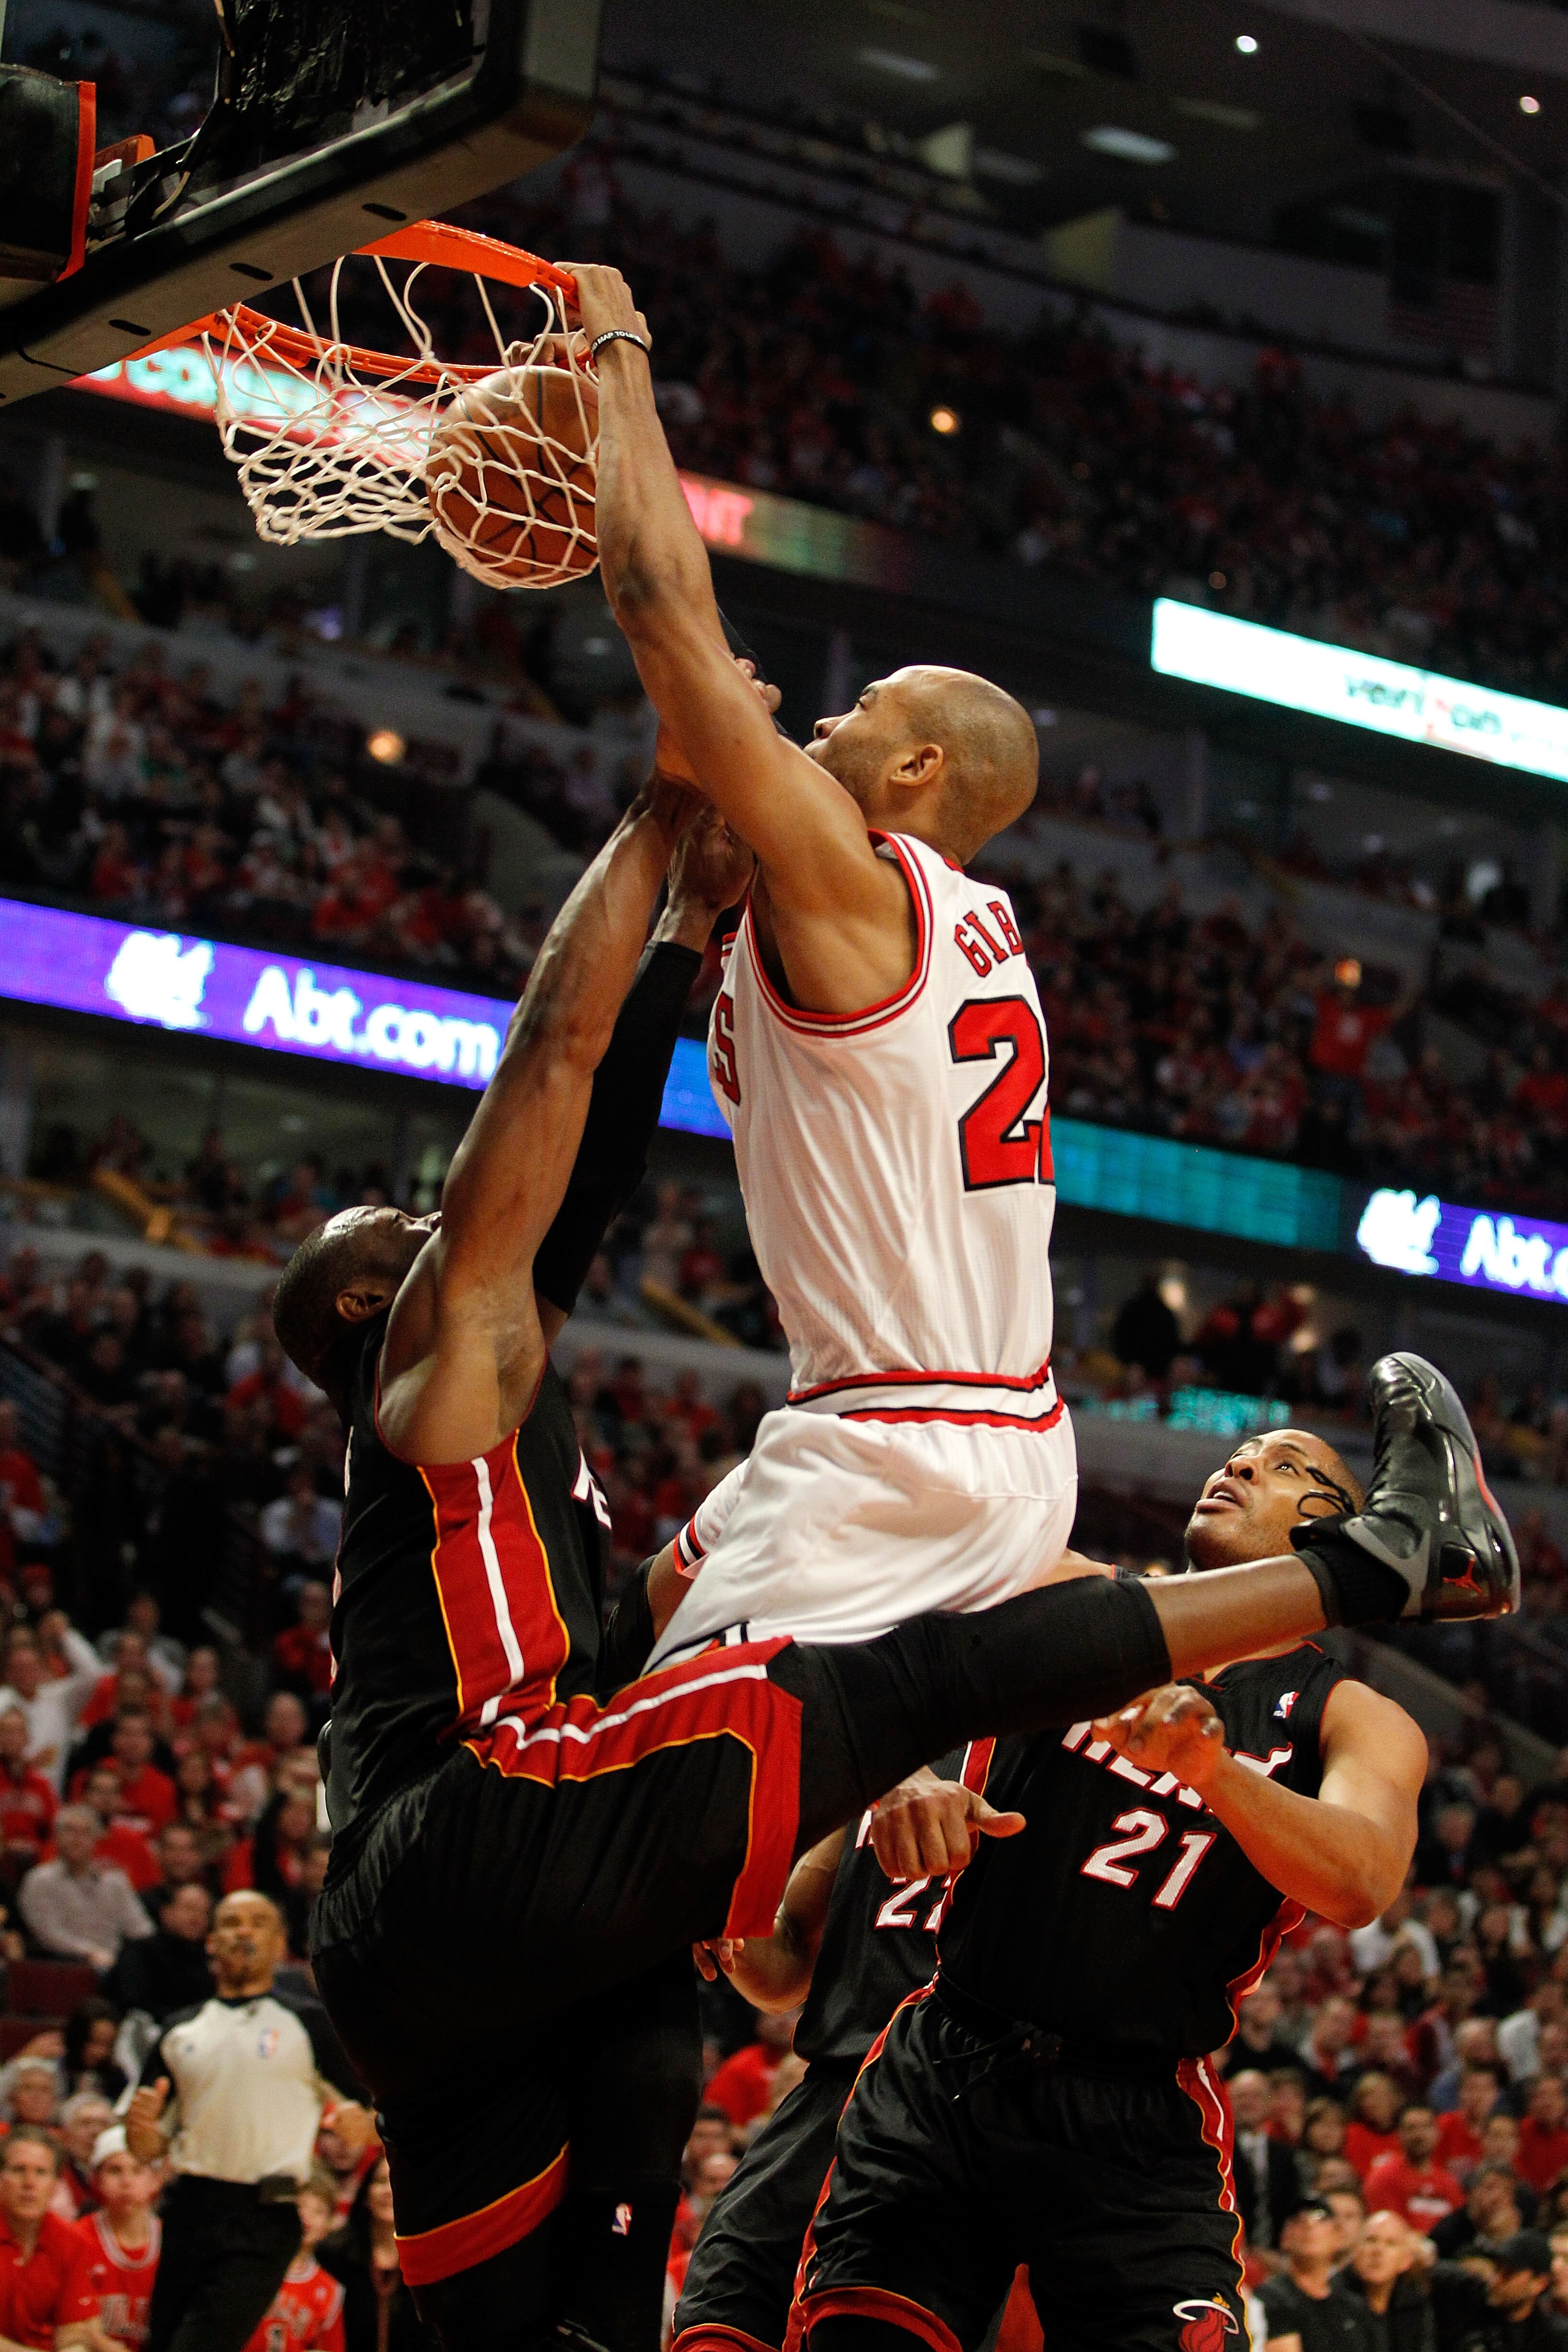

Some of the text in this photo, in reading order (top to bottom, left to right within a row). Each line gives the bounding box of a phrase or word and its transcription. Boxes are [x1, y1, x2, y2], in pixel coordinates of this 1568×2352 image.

[243, 965, 501, 1082] Abt.com
[948, 994, 1055, 1191] 2
[1080, 1807, 1217, 1911] 21
